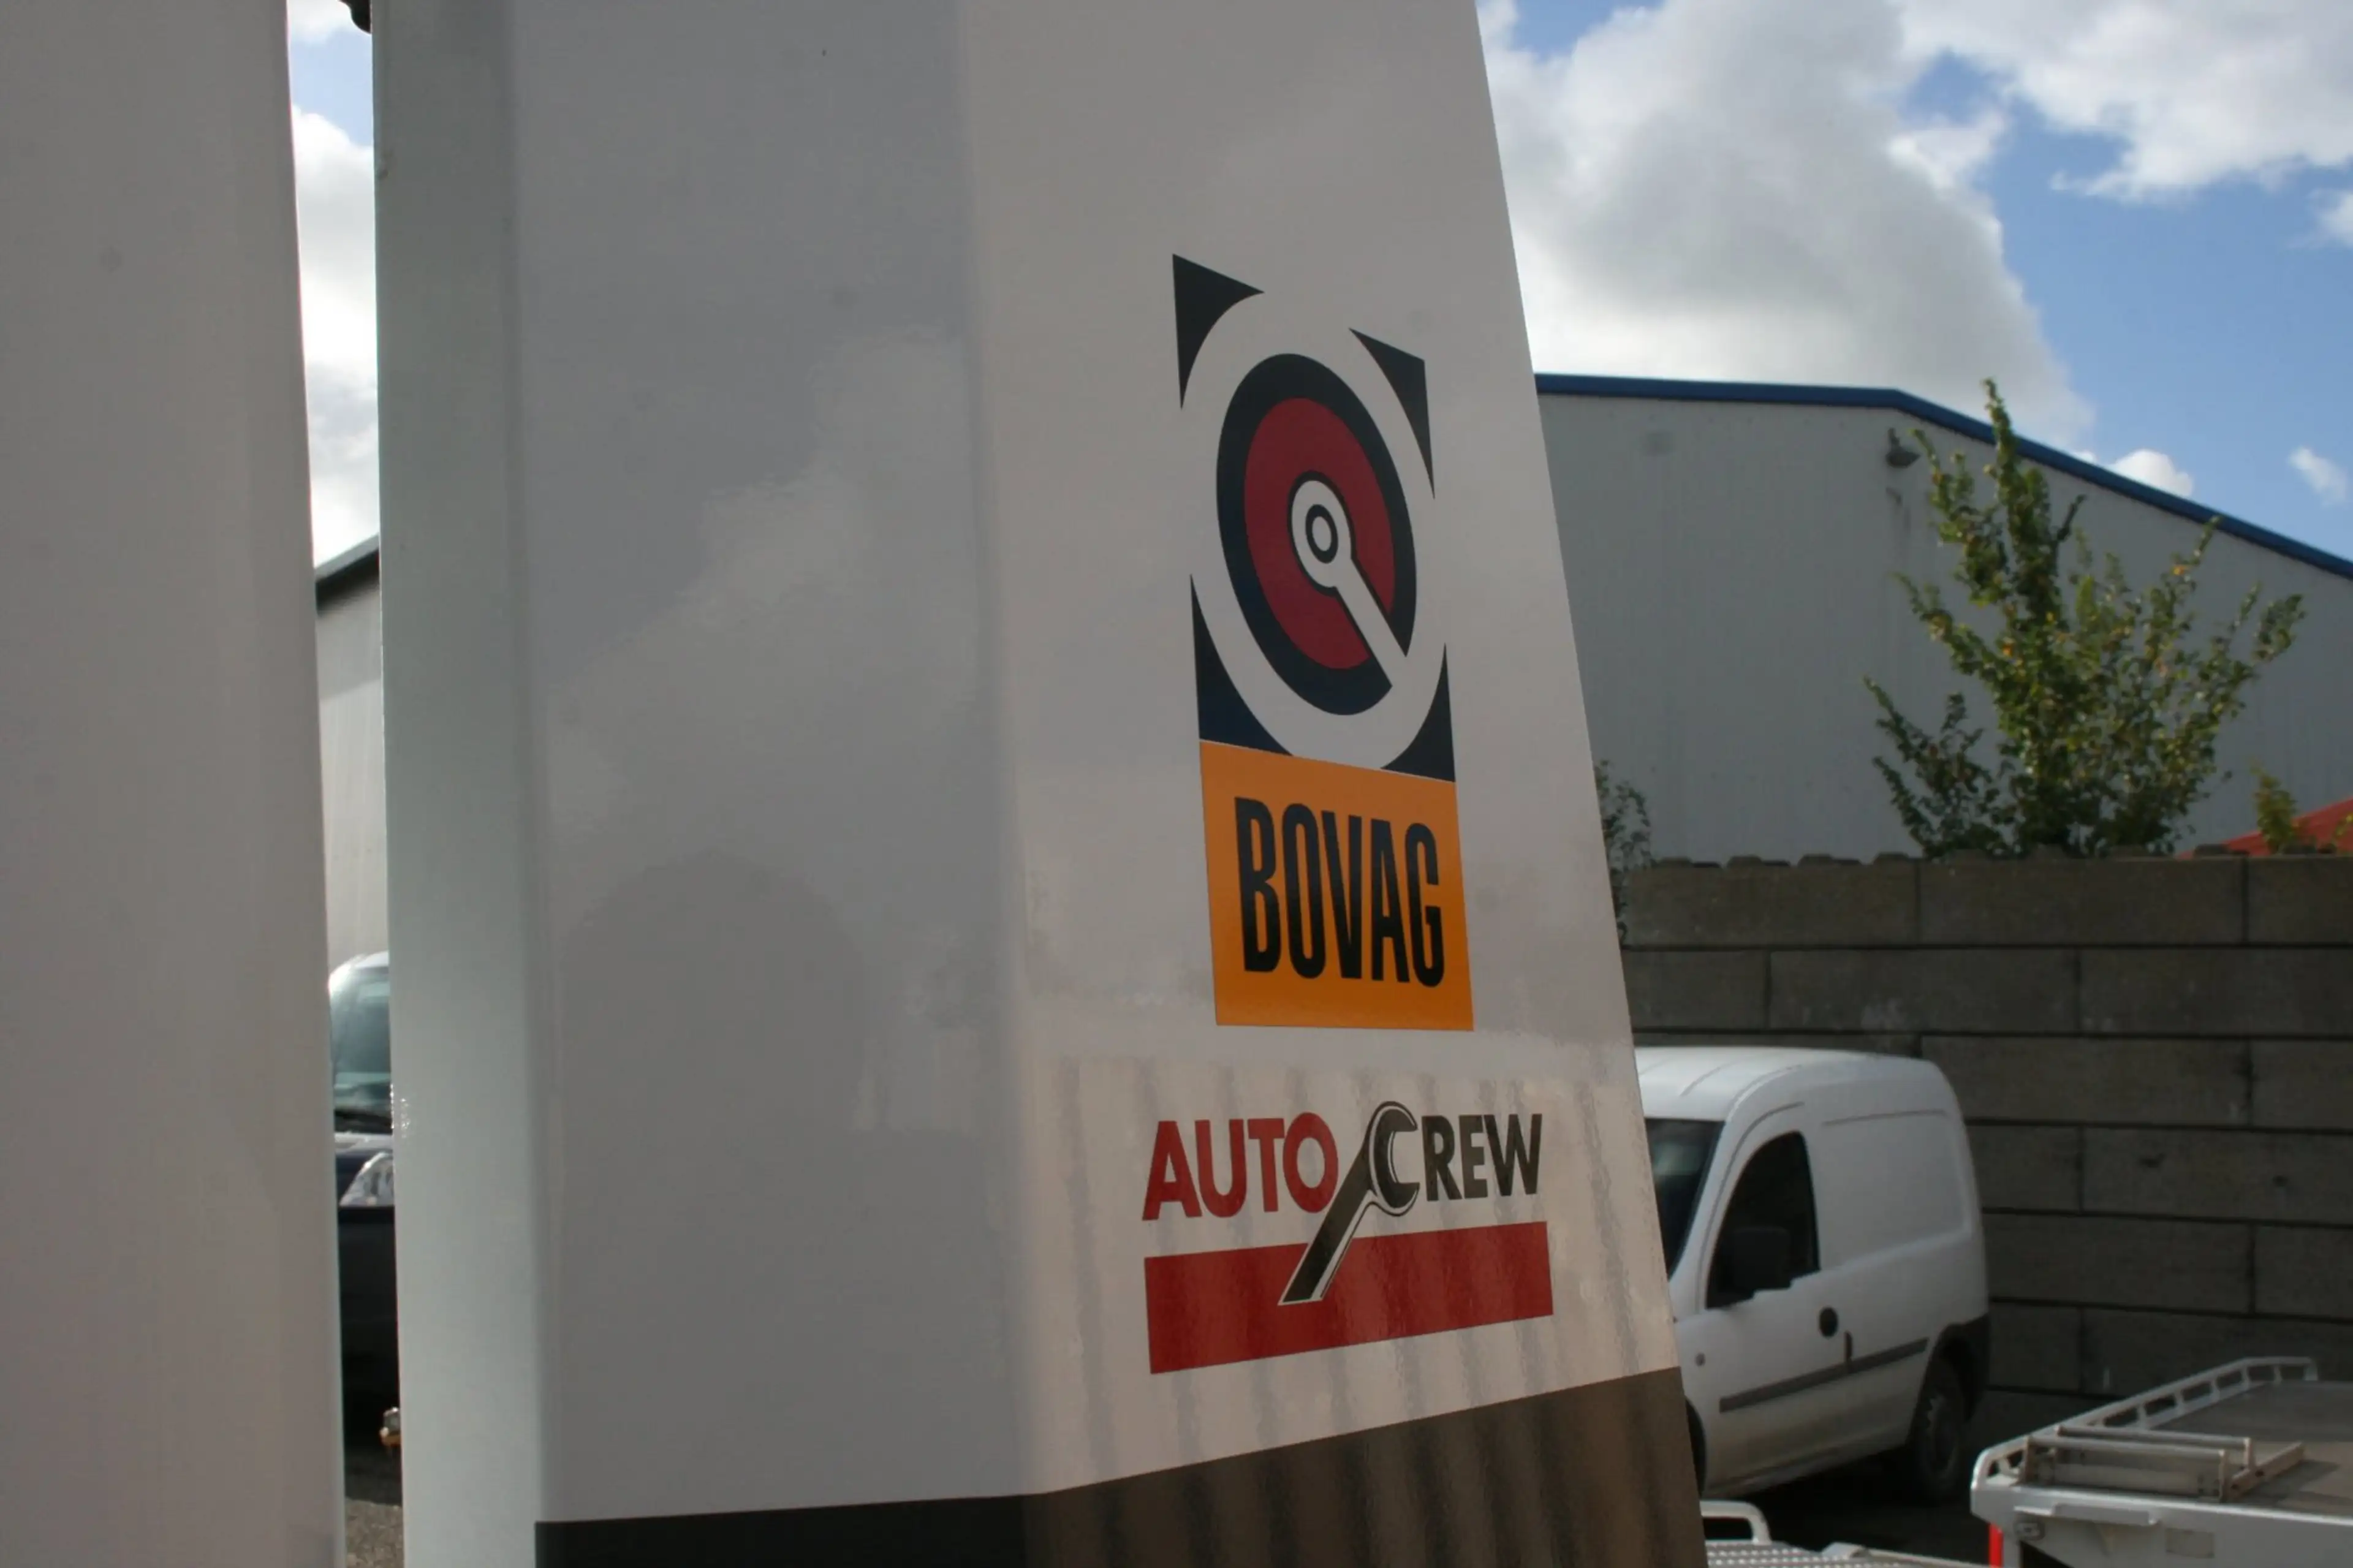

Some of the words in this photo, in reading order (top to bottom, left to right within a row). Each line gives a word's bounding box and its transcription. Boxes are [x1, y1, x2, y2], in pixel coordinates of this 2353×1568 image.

[1234, 797, 1445, 988] BOVAG
[1142, 1112, 1339, 1221] AUTO
[1368, 1101, 1543, 1216] CREW
